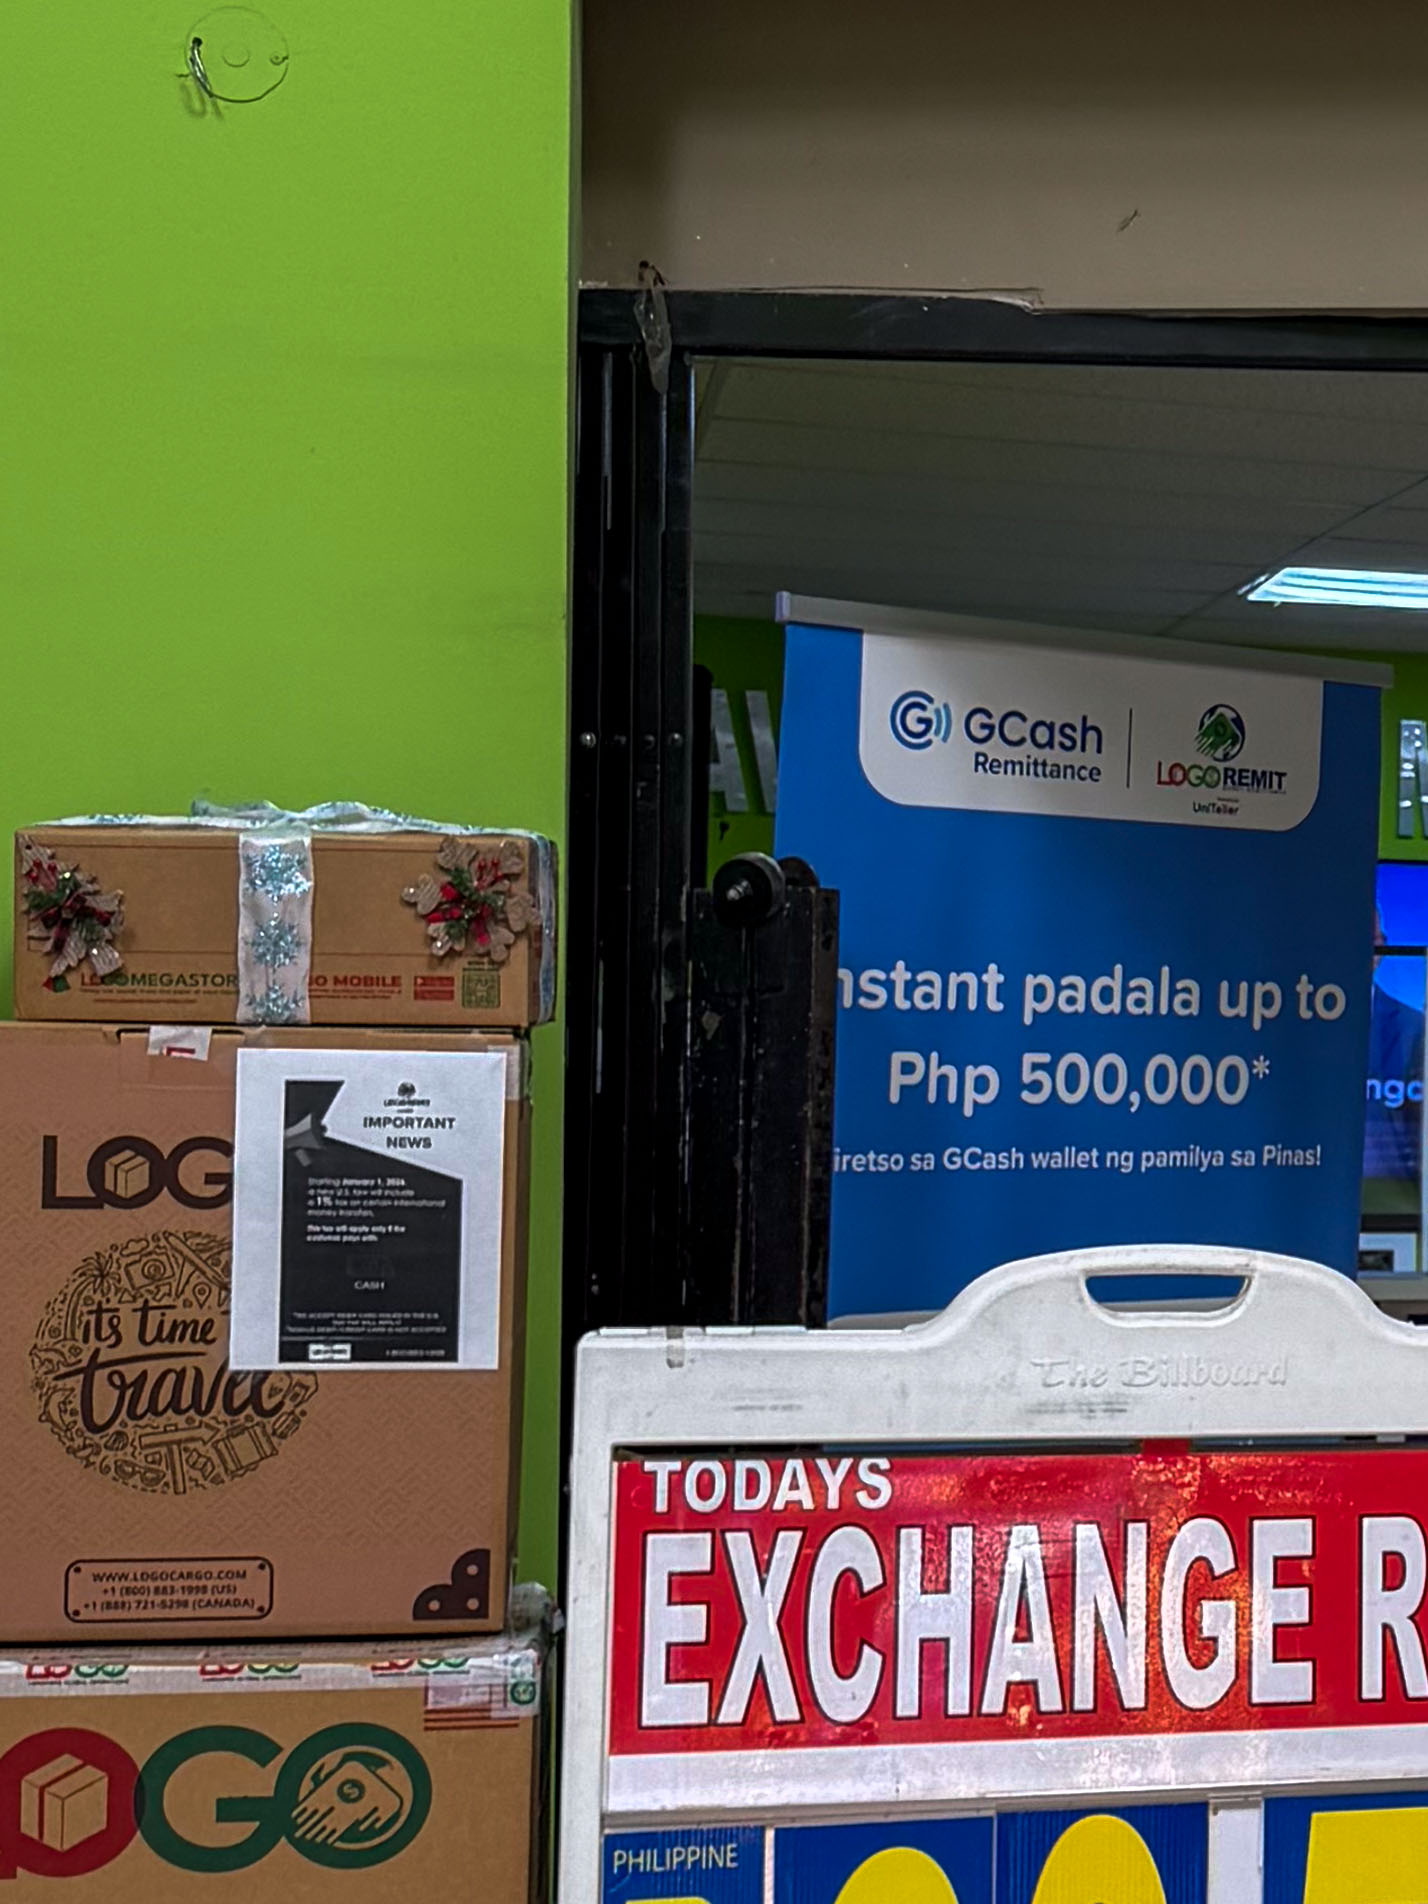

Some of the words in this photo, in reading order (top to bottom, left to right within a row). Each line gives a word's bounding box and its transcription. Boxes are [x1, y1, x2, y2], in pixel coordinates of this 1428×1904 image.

[964, 707, 1103, 755] GCash
[974, 752, 1101, 782] Remittance
[838, 960, 1005, 1012] nstant
[1024, 963, 1200, 1026] padala
[1219, 980, 1282, 1031] up
[1296, 974, 1346, 1021] to
[888, 1050, 1000, 1117] Php
[363, 1116, 456, 1130] IMPORTANT
[386, 1137, 432, 1149] NEWS
[42, 1136, 232, 1210] LOG
[833, 1148, 904, 1172] iretso
[910, 1152, 935, 1171] sa
[943, 1146, 1024, 1171] GCash
[1031, 1145, 1099, 1170] wallet
[1106, 1150, 1133, 1173] ng
[1141, 1145, 1224, 1173] pamilya
[1231, 1150, 1255, 1168] sa
[1262, 1144, 1321, 1167] Pinas!
[132, 1298, 216, 1346] time
[644, 1456, 892, 1514] TODAYS
[92, 1569, 246, 1583] WWW.LOGOCARGO.COM
[640, 1517, 1316, 1729] EXCHANGE
[0, 1723, 432, 1879] OGO
[612, 1843, 739, 1875] PHILIPPINE
